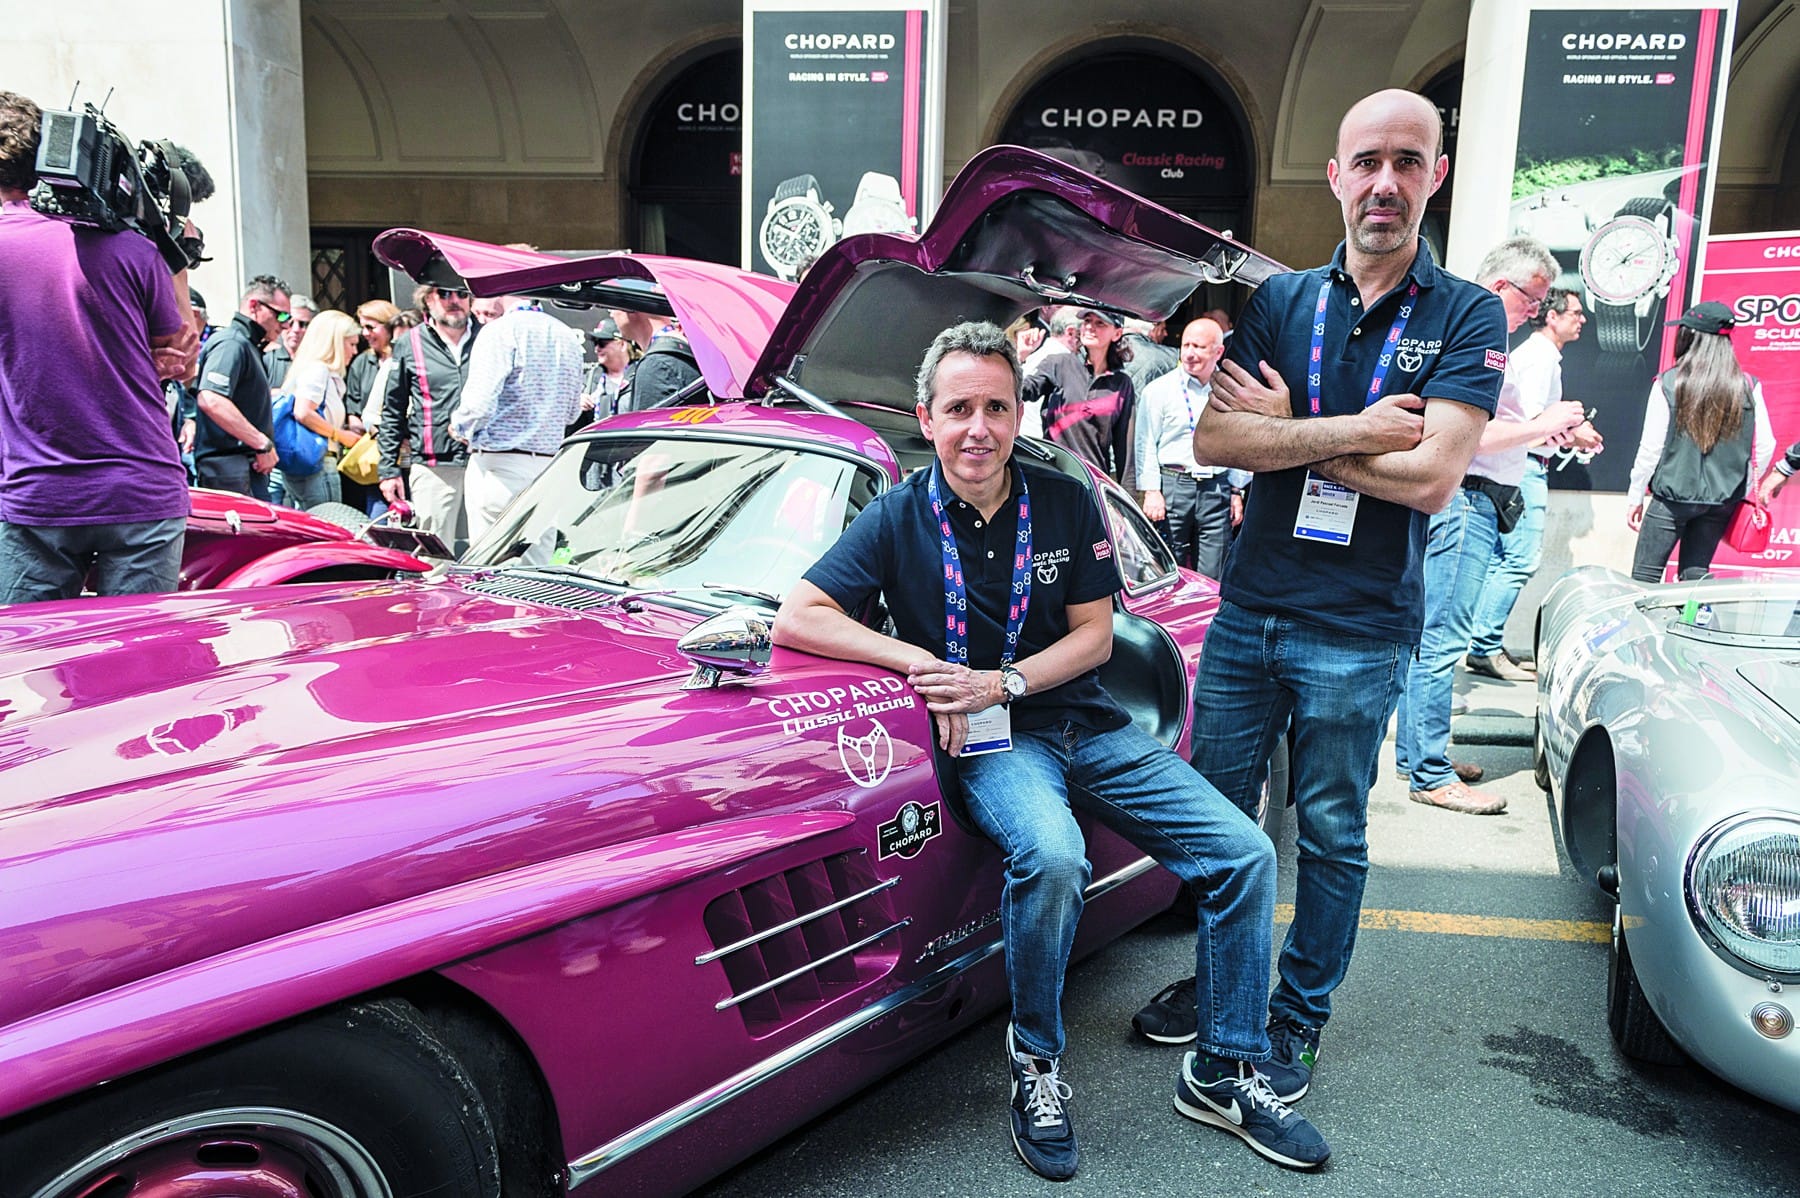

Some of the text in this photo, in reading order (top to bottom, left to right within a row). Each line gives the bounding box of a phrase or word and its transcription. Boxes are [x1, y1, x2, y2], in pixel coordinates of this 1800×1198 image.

[785, 34, 895, 50] CHOPARD
[1561, 33, 1686, 50] CHOPARD
[788, 72, 824, 82] RACING
[825, 72, 837, 82] IN
[1563, 74, 1602, 84] RACING
[1604, 74, 1616, 84] IN
[677, 103, 740, 122] CHO
[1041, 108, 1203, 128] CHOPARD
[1122, 152, 1225, 169] Classic Racing
[1160, 168, 1184, 179] Club
[1032, 548, 1069, 562] OPARD
[768, 676, 904, 718] CHOPARD
[782, 694, 915, 736] Classic Racing
[889, 827, 932, 851] CHOPARD
